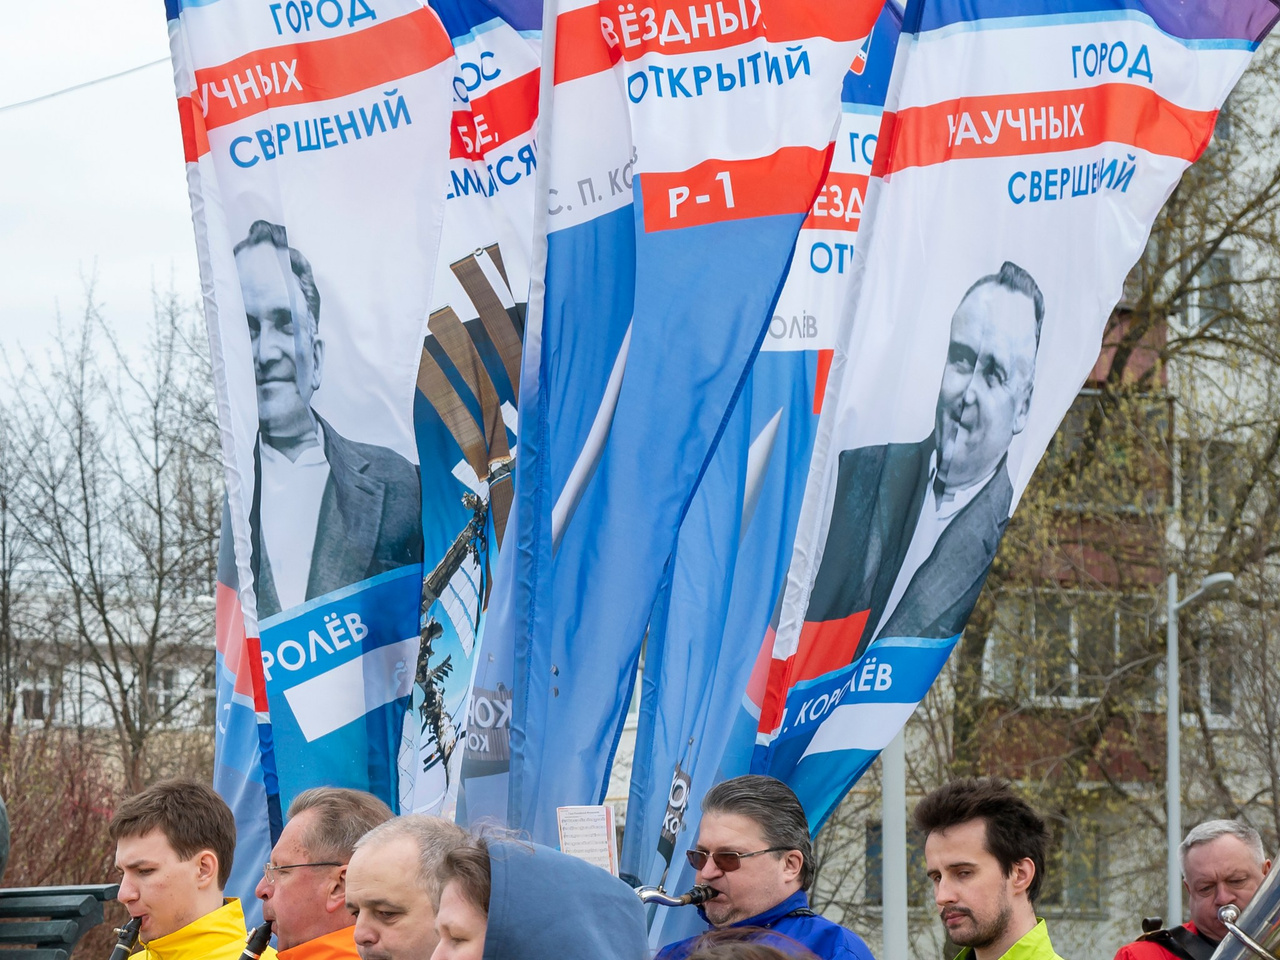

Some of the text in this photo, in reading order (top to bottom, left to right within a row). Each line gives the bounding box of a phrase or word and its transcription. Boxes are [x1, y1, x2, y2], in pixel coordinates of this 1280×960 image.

[270, 0, 377, 35] ГОРОД
[627, 45, 811, 104] ОТКРЫТИЙ
[1071, 40, 1153, 83] ГОРОД
[229, 88, 412, 168] СВРШЕНИЙ
[947, 103, 1085, 147] НАУЧНЫХ
[577, 177, 603, 206] П.
[668, 171, 735, 218] Р-1
[1008, 153, 1137, 205] СВЕРШЕИЙ
